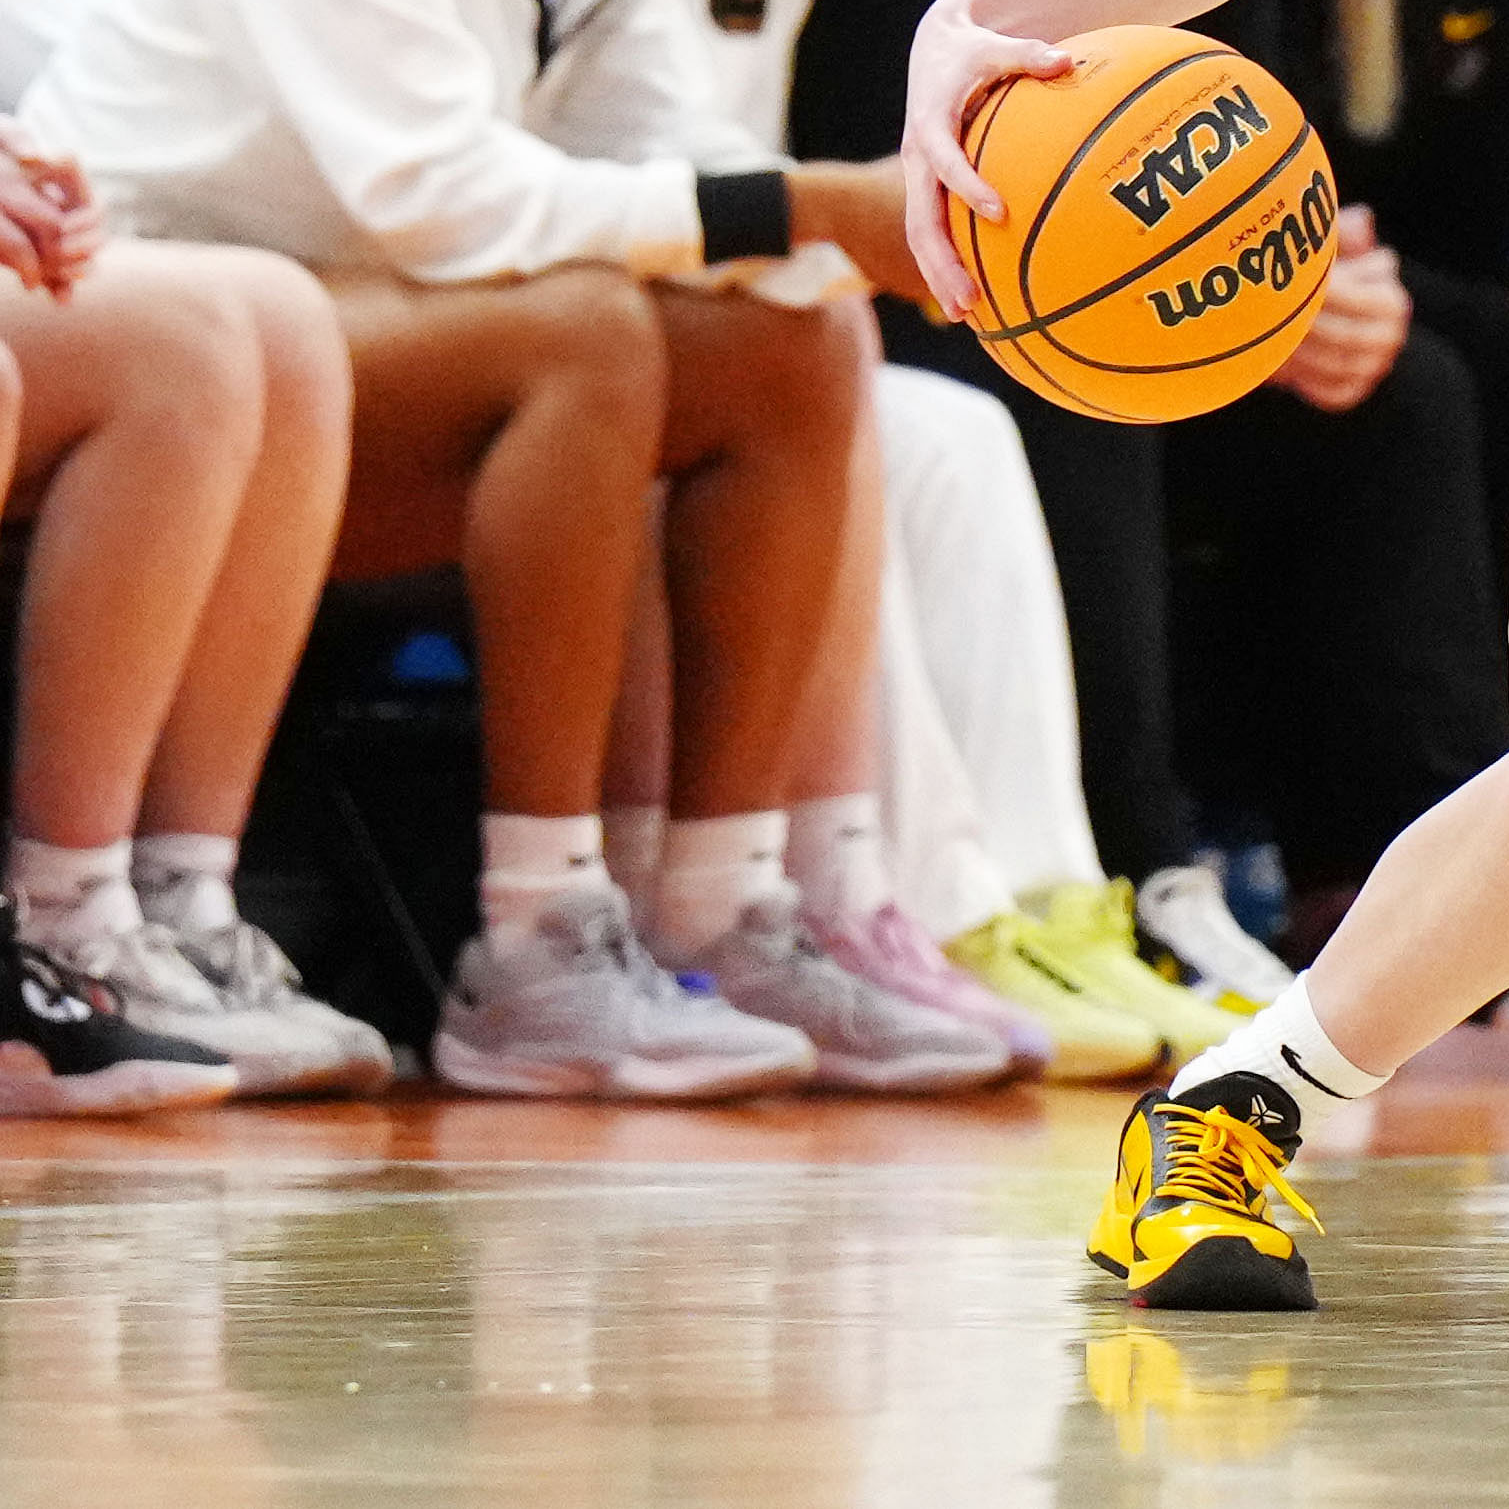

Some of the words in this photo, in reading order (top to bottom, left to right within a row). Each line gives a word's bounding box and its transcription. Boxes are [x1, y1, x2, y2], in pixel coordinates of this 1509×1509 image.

[1110, 84, 1271, 228] NCAA
[1148, 170, 1337, 327] Wilson
[1228, 225, 1258, 251] NXT
[1259, 198, 1286, 226] EVO
